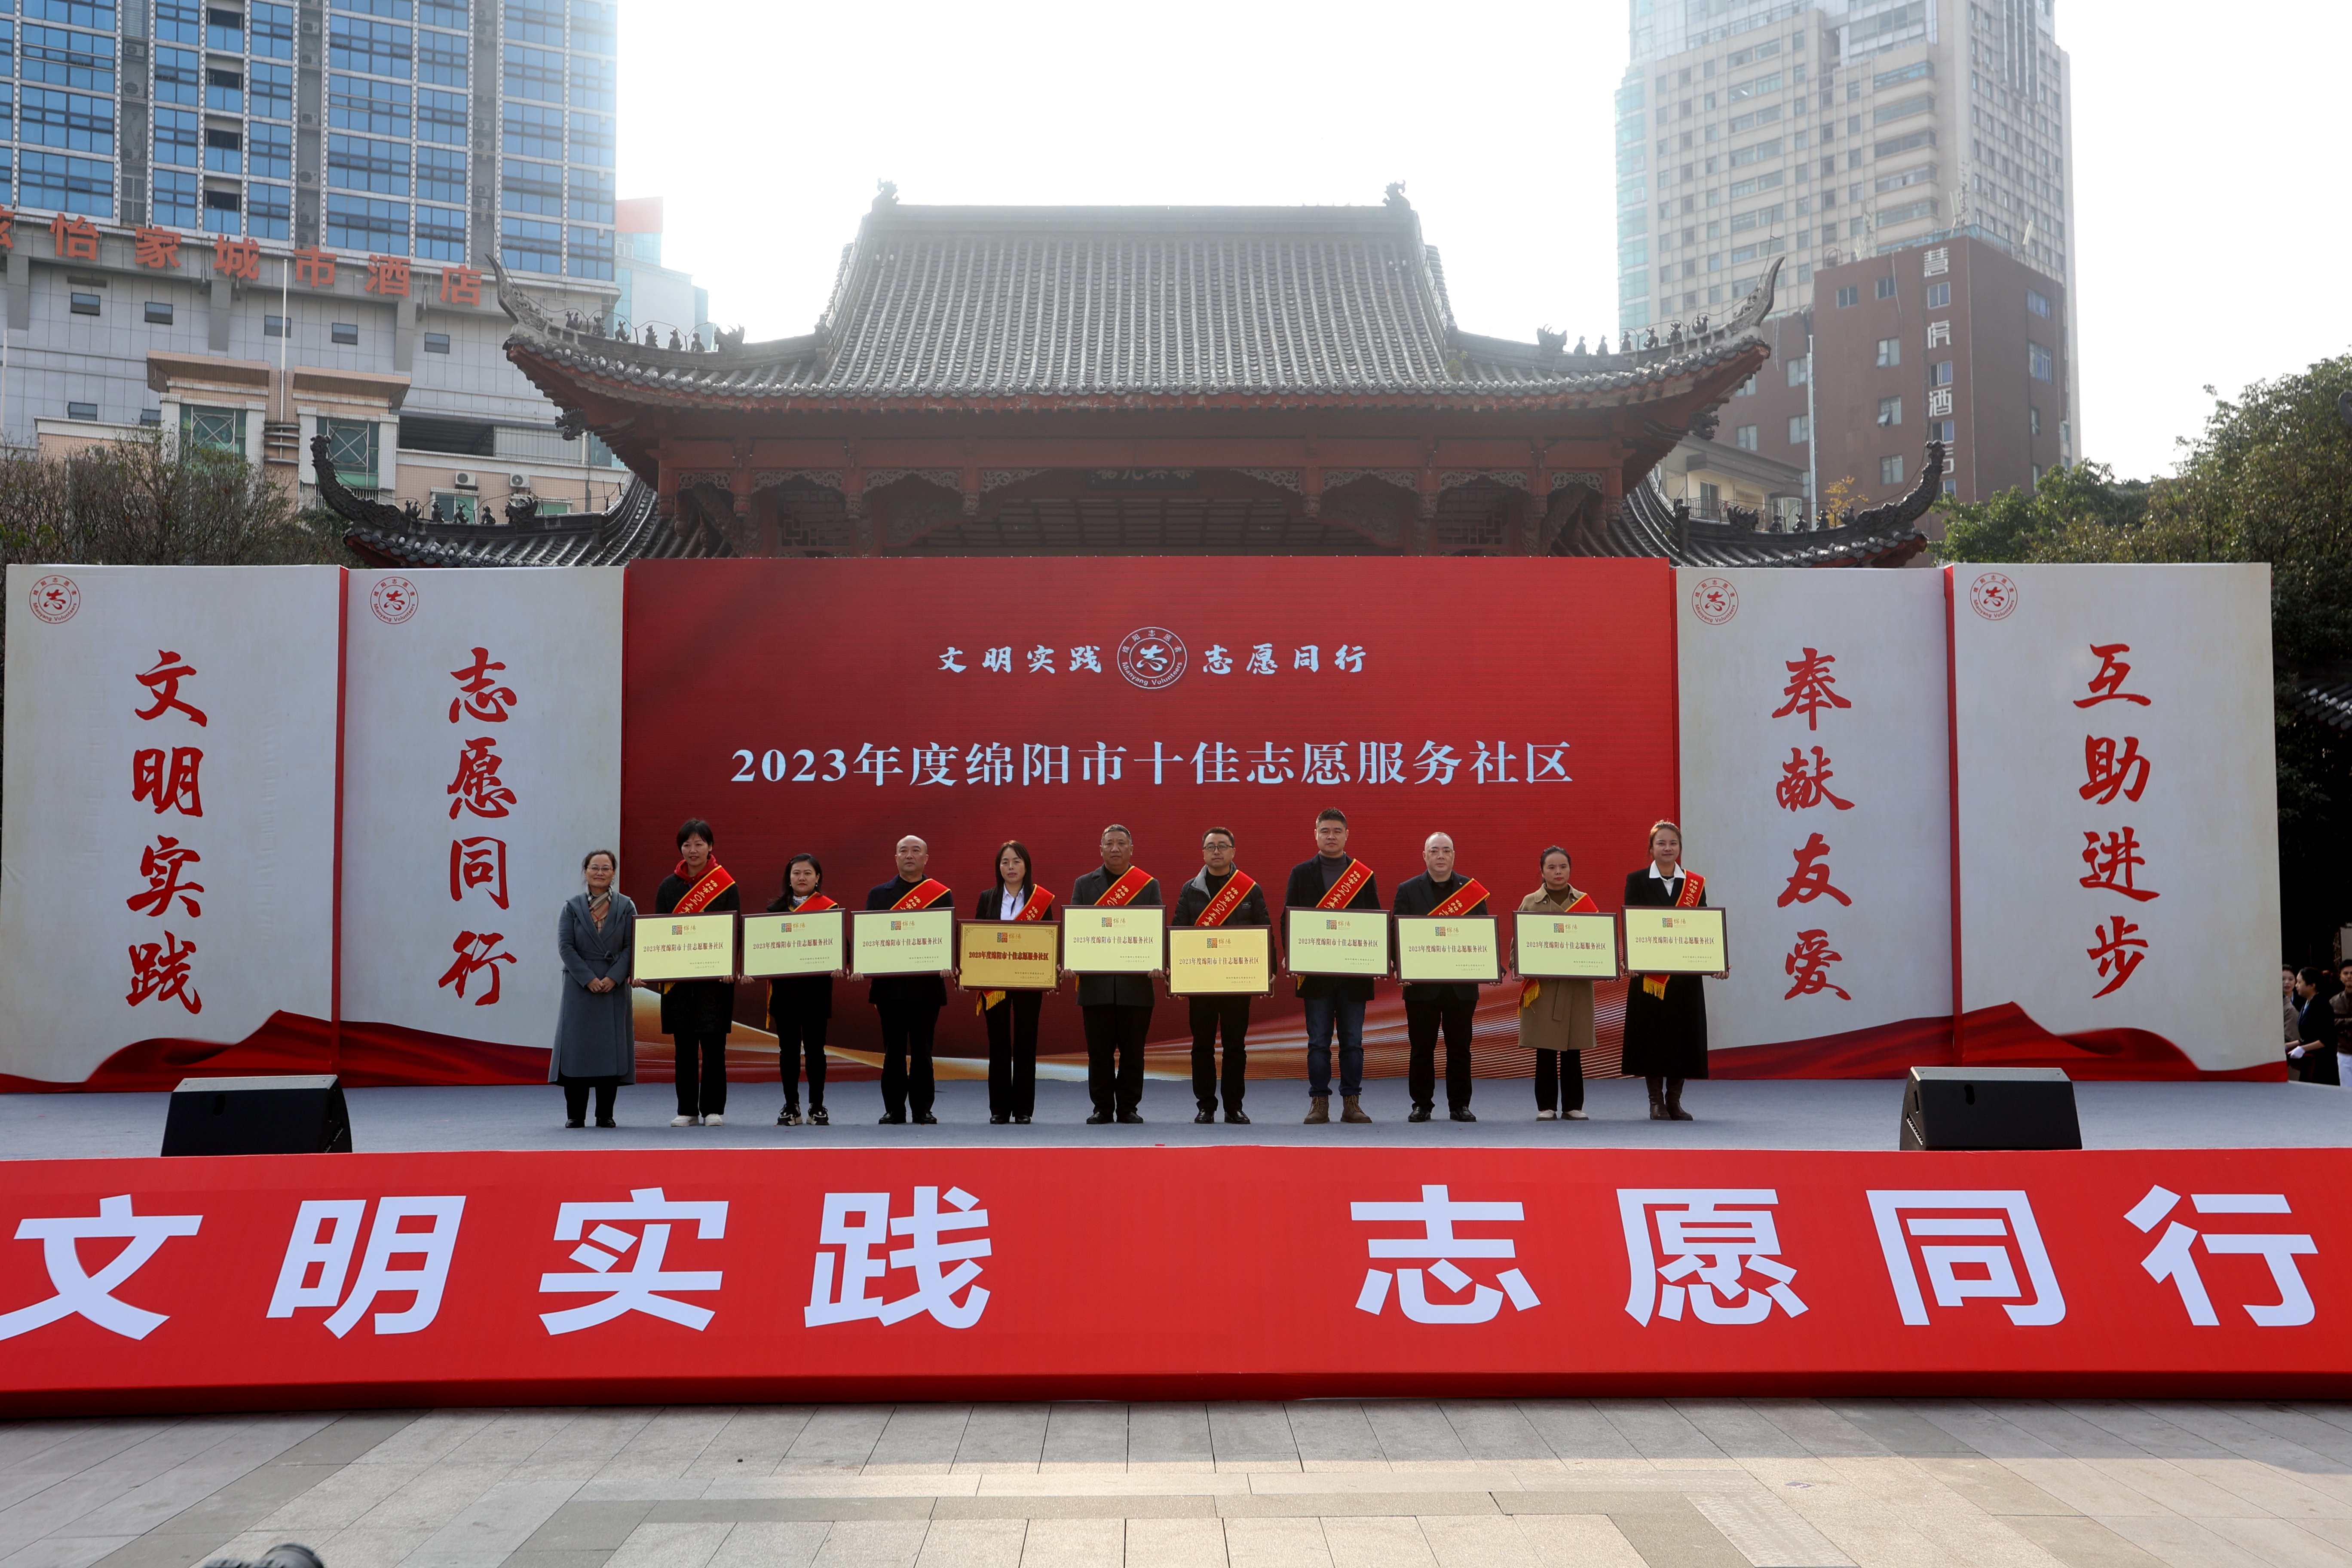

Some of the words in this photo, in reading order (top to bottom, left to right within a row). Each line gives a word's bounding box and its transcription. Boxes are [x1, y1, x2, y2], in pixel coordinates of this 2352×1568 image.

[33, 603, 52, 621] Mianyang
[54, 603, 77, 621] Volunteers
[374, 603, 392, 622] Mianyang
[394, 604, 415, 621] Volunteers
[1695, 604, 1713, 622] Mianyang
[1715, 605, 1735, 622] Volunteers
[938, 645, 1102, 674] 文明实践
[1203, 643, 1366, 674] 志愿同行
[1122, 662, 1148, 686] Mianyang
[1152, 662, 1182, 685] Volunteers
[731, 740, 1573, 786] 2023年度绵阳市十佳志愿服务社区
[439, 647, 517, 1006] 志愿同行
[1772, 647, 1855, 1000] 奉献友爱
[2073, 643, 2160, 999] 互助进步
[126, 649, 207, 1014] 文明实践
[643, 942, 723, 952] 2023年度绵阳市十佳志愿服务社区
[753, 938, 833, 949] 2023年度绵阳市十佳志愿服务社区
[863, 937, 943, 947] 2023年度绵阳市十佳志愿服务社区
[1073, 936, 1154, 944] 2023年度绵阳市十佳志愿服务社区
[1298, 938, 1378, 947] 2023年度绵阳市十佳志愿服务社区
[1526, 941, 1606, 950] 2023年度绵阳市十佳志愿服务社区
[1635, 936, 1715, 944] 2023年度绵阳市十佳志愿服务社区
[969, 951, 1049, 961] 2023年度绵阳市十佳志愿服务社区
[1179, 957, 1259, 965] 2023年度绵阳市十佳志愿服务社区
[0, 1186, 992, 1341] 文明实践
[1350, 1185, 2318, 1328] 志愿同行
